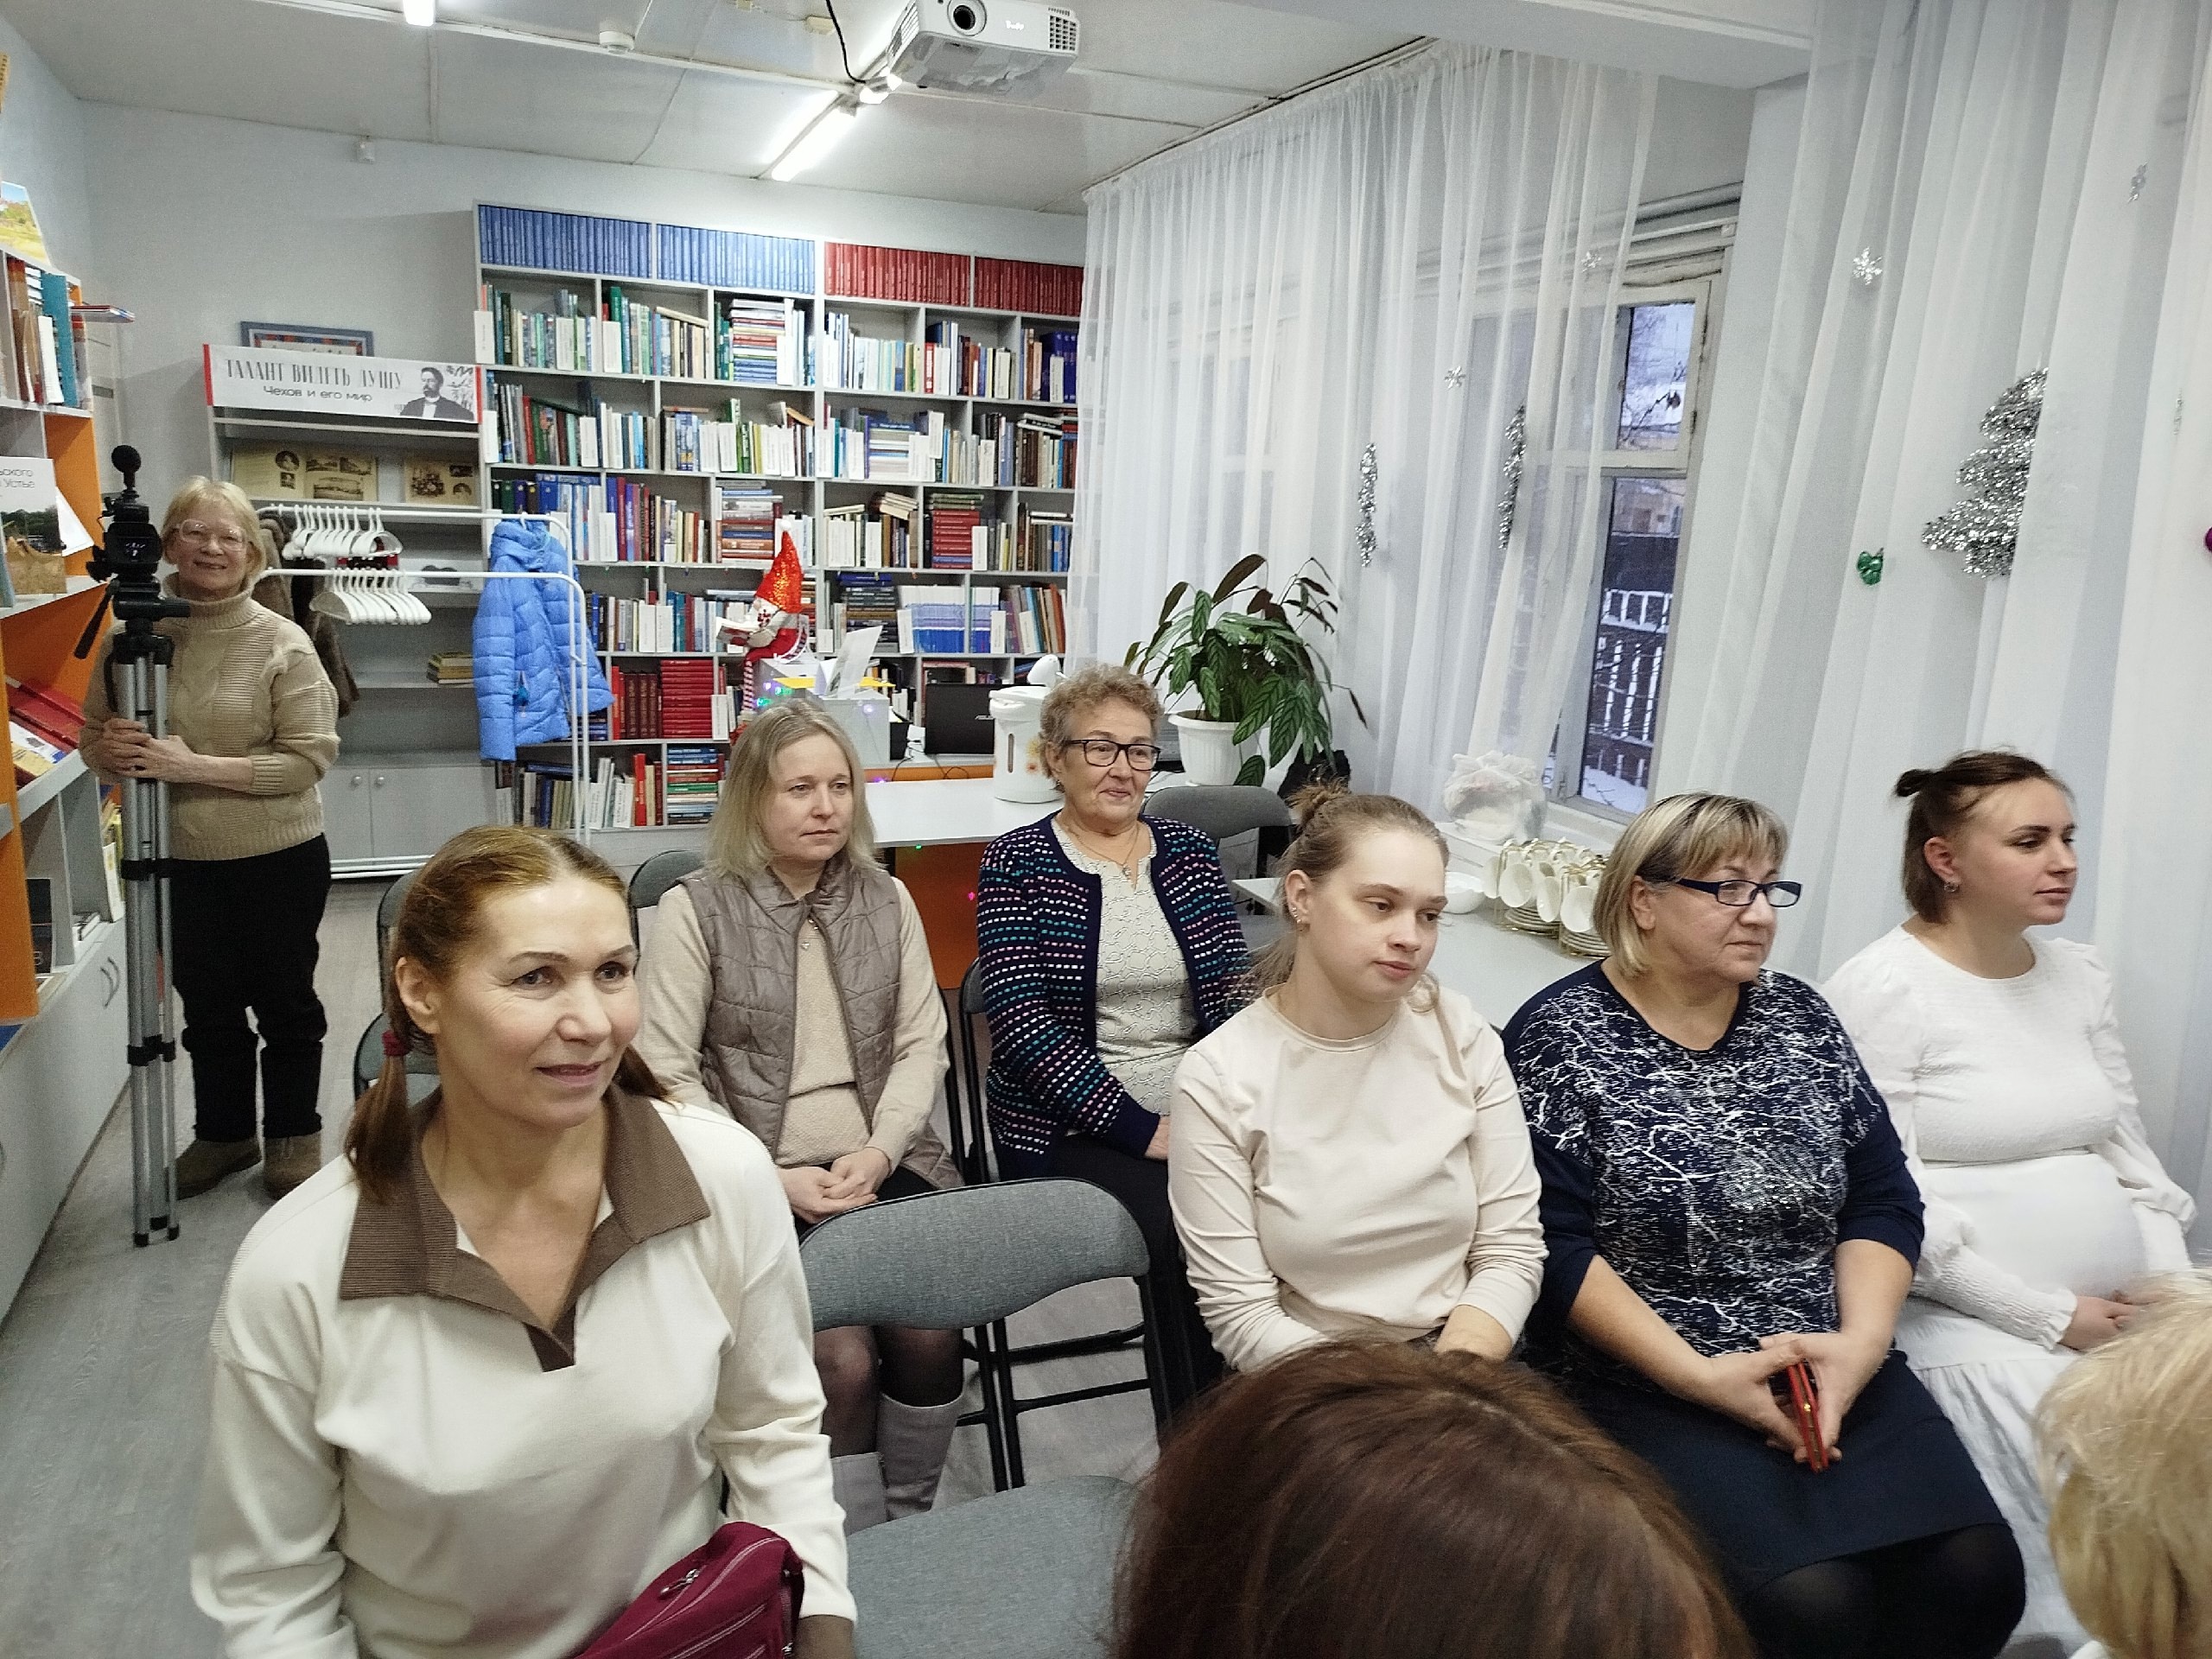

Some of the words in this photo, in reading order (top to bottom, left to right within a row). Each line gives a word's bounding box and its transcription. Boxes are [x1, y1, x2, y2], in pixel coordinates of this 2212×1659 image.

[226, 359, 283, 381] ТАЛАНТ
[292, 364, 351, 387] ВИДЕТЬ
[359, 369, 402, 390] ДУШУ
[263, 385, 302, 397] Чехов
[320, 391, 342, 399] его
[346, 392, 372, 403] мир
